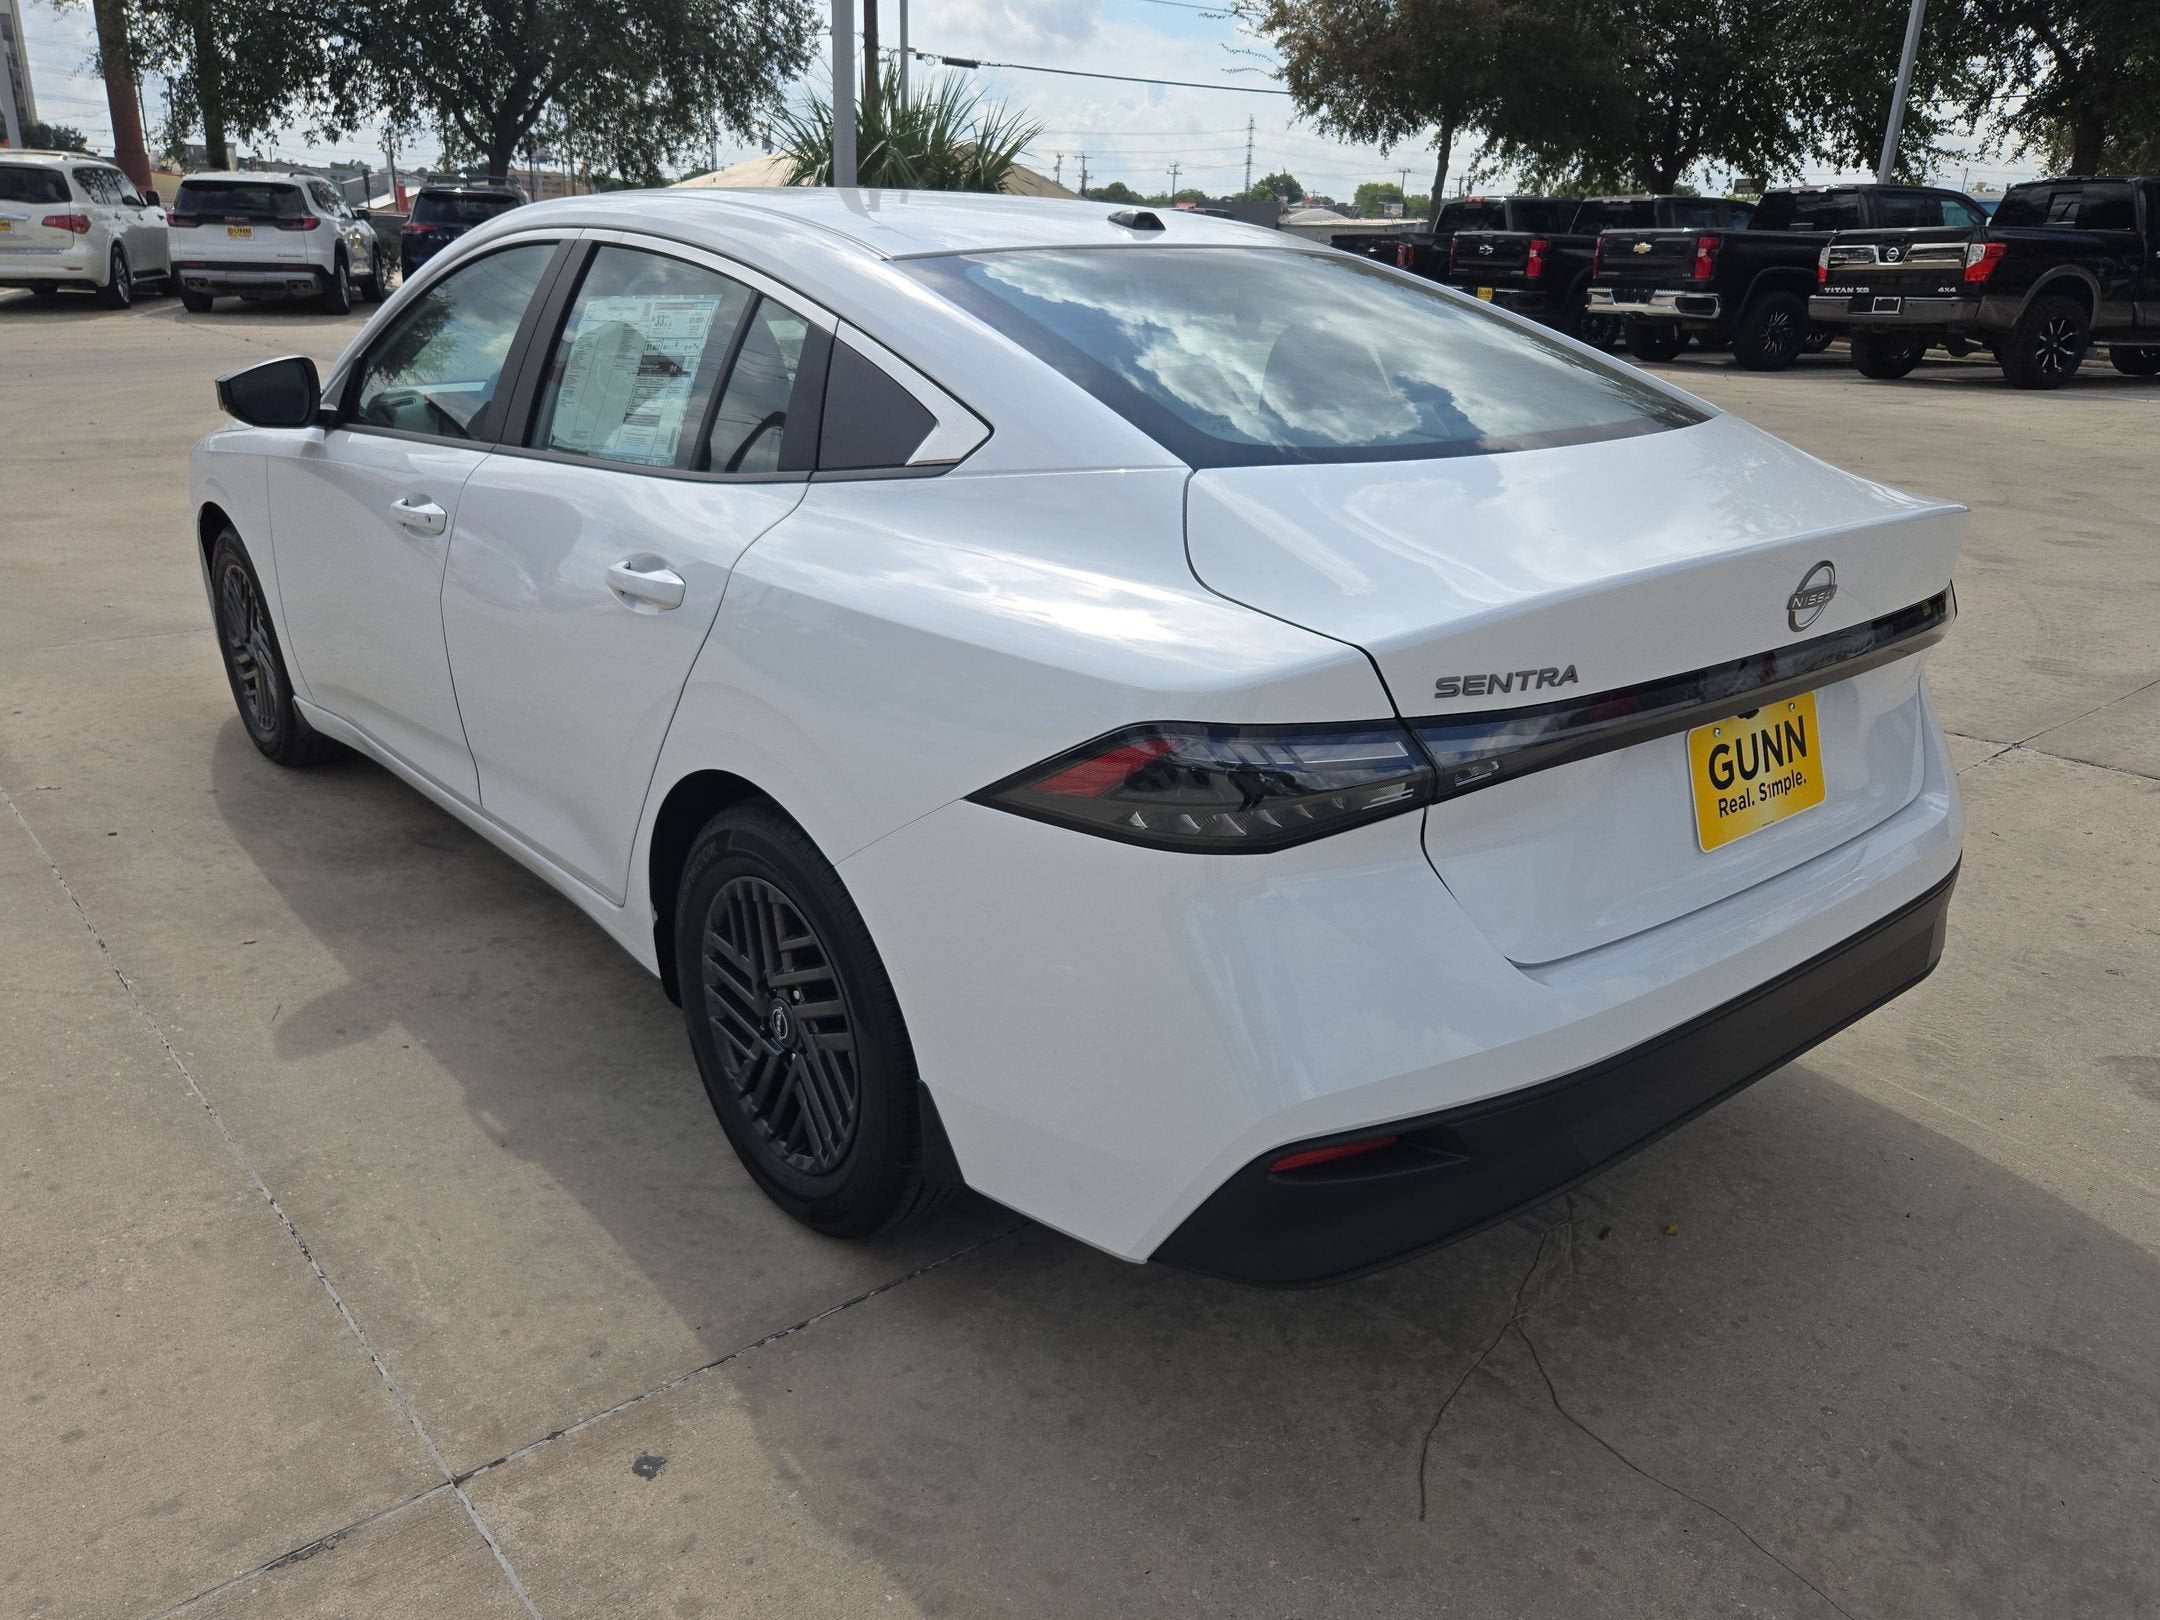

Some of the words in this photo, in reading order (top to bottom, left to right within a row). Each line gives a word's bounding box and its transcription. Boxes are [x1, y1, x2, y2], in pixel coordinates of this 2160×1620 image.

[1823, 286, 1854, 294] TITAN
[1856, 286, 1870, 294] XD
[1434, 664, 1579, 699] SENTRA
[1708, 714, 1808, 791] GUNN
[1717, 787, 1755, 819] Real.
